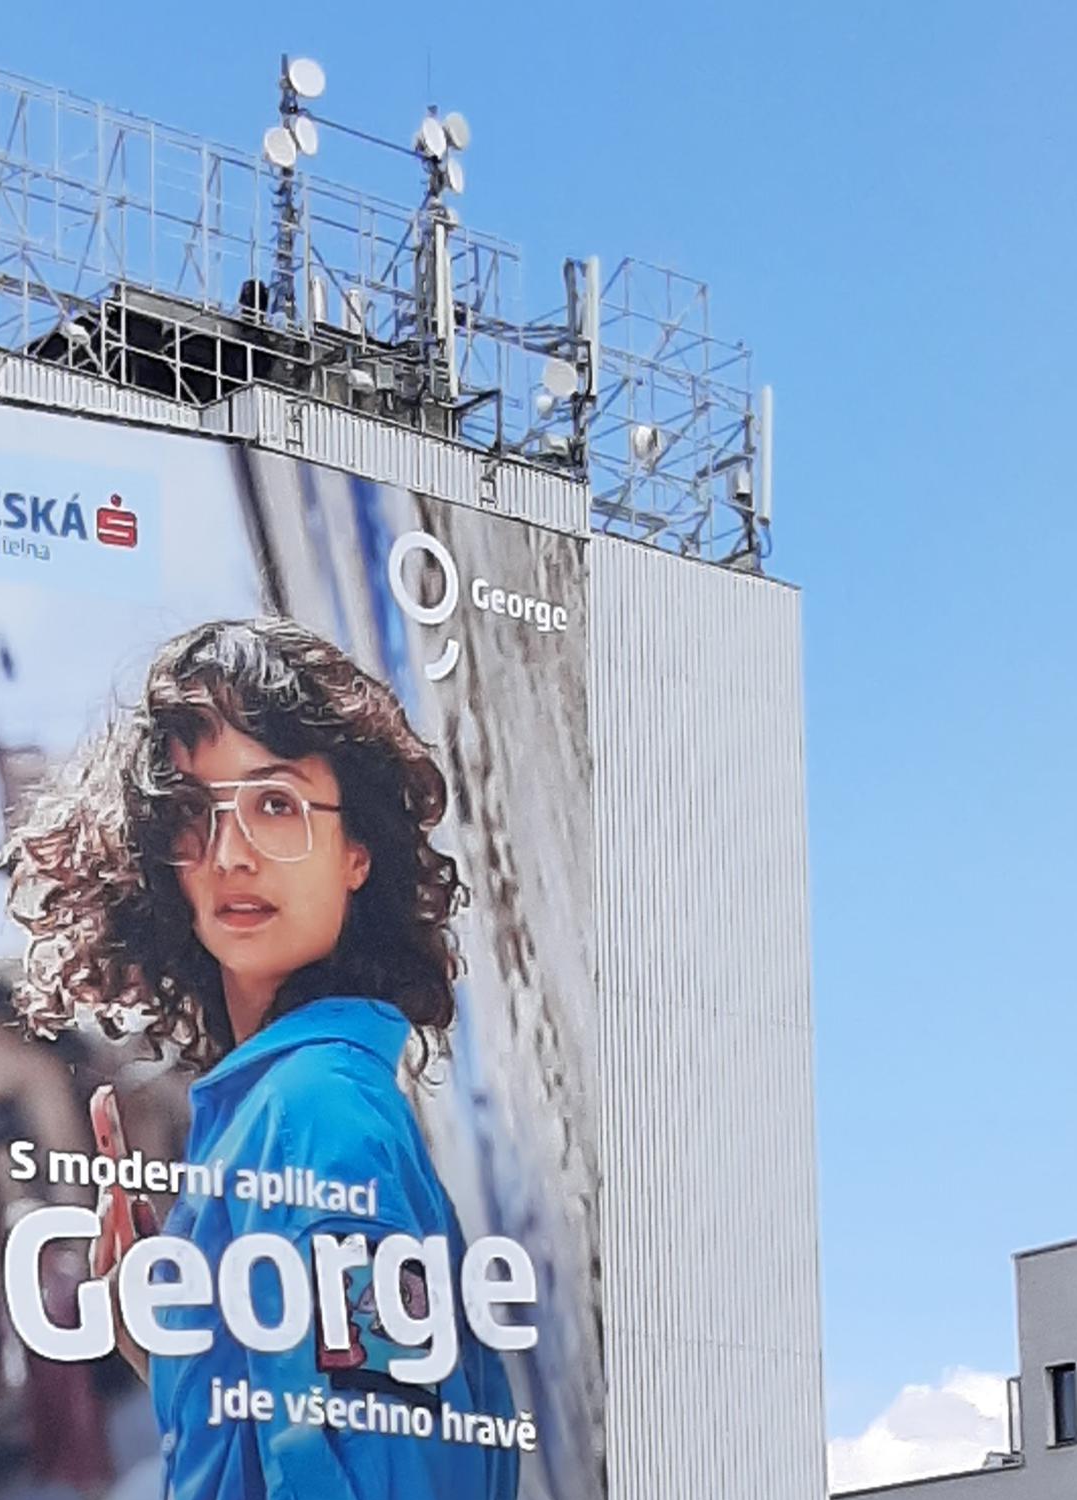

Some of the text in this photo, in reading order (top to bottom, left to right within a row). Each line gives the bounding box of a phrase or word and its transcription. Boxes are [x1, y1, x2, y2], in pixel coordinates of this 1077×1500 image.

[472, 577, 568, 632] George
[9, 1141, 378, 1218] S moderní aplikací
[4, 1206, 538, 1385] George
[208, 1378, 537, 1452] jde všechno hravě
